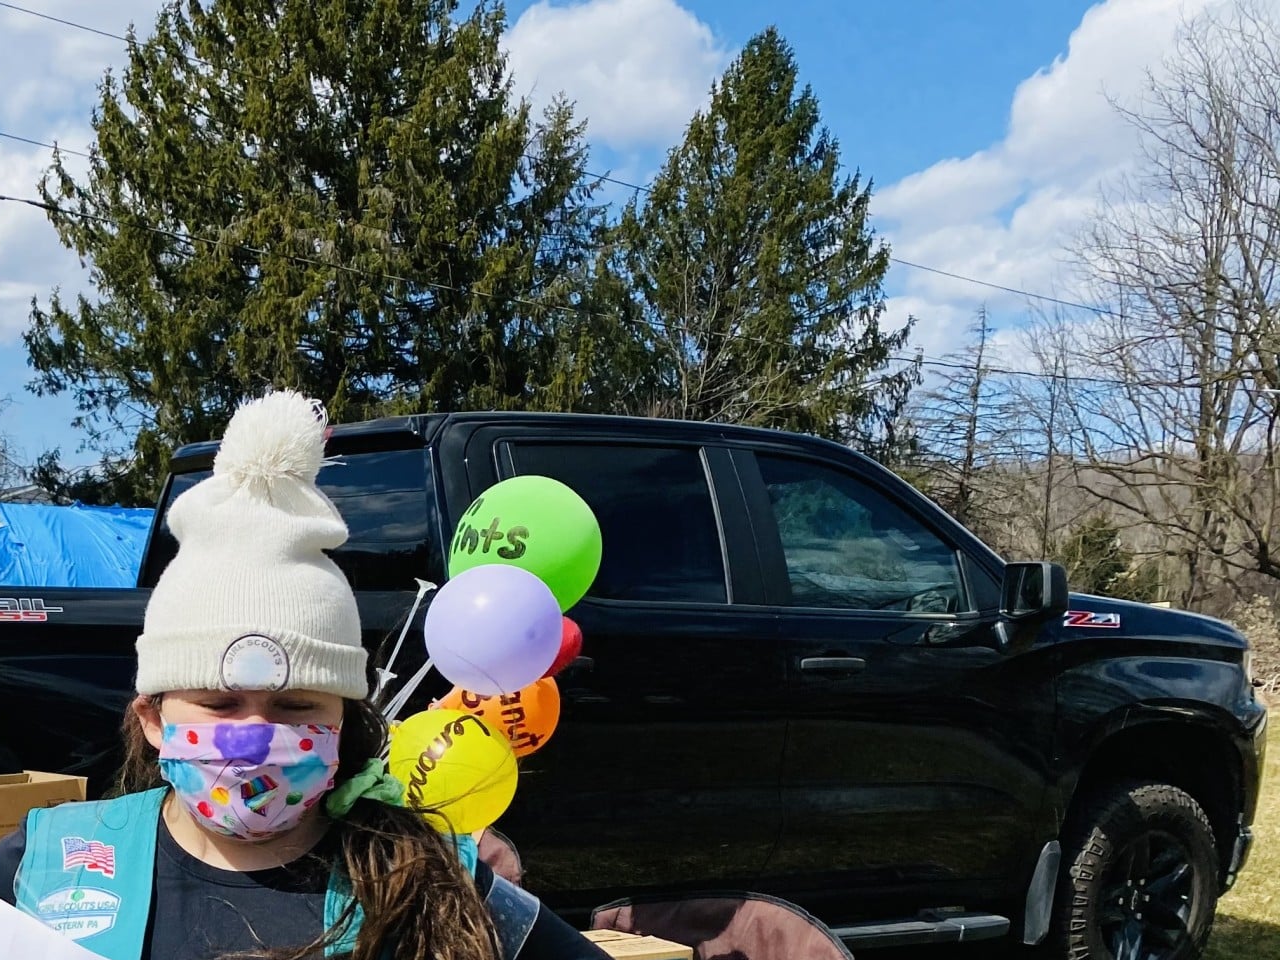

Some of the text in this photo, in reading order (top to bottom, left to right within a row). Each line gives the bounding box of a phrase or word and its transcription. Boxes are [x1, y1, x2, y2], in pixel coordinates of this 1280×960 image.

[449, 516, 530, 560] ints
[226, 639, 282, 666] GIRL SCOUTS
[407, 715, 491, 812] Lemona
[59, 901, 96, 911] SCOUTS
[97, 900, 116, 909] USA
[54, 920, 98, 931] STERN PA
